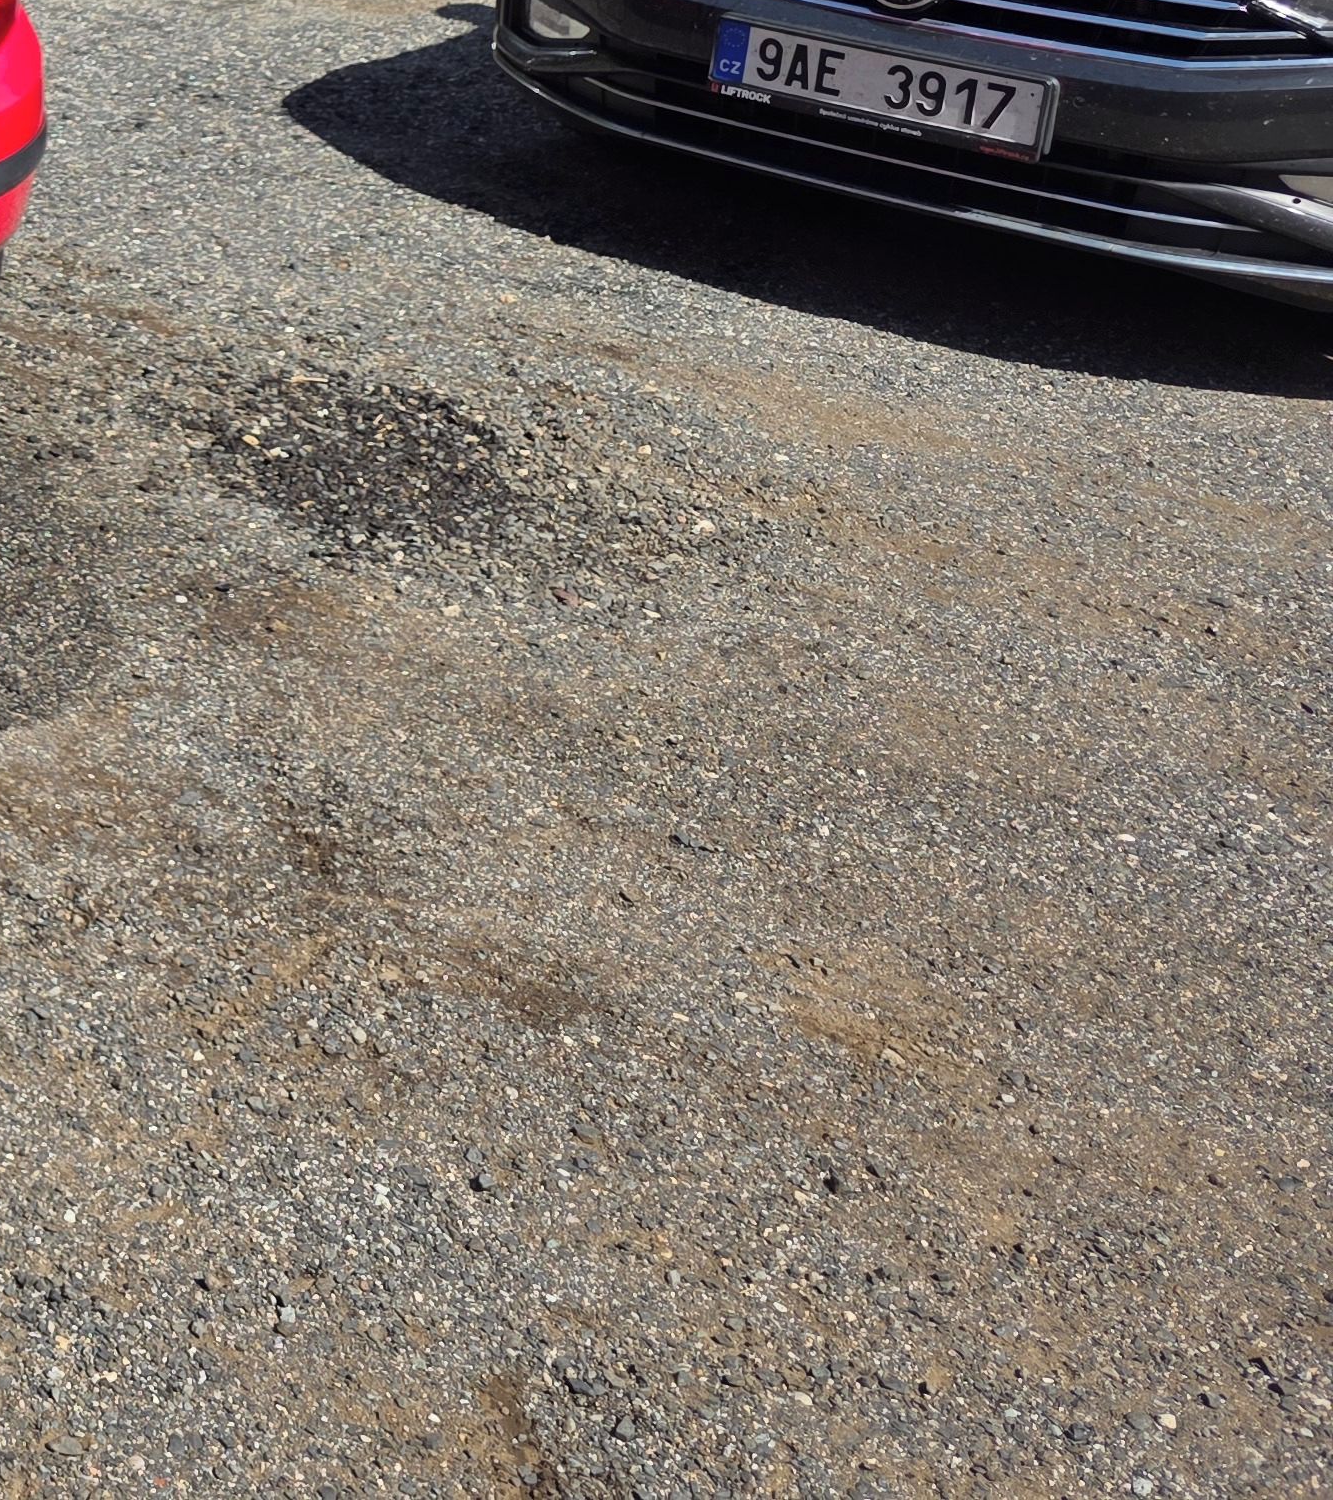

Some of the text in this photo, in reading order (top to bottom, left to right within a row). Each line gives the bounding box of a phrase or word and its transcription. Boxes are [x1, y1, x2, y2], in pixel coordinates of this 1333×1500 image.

[719, 37, 1017, 130] CZ 9AE 3917
[720, 84, 773, 105] LIFTROCK
